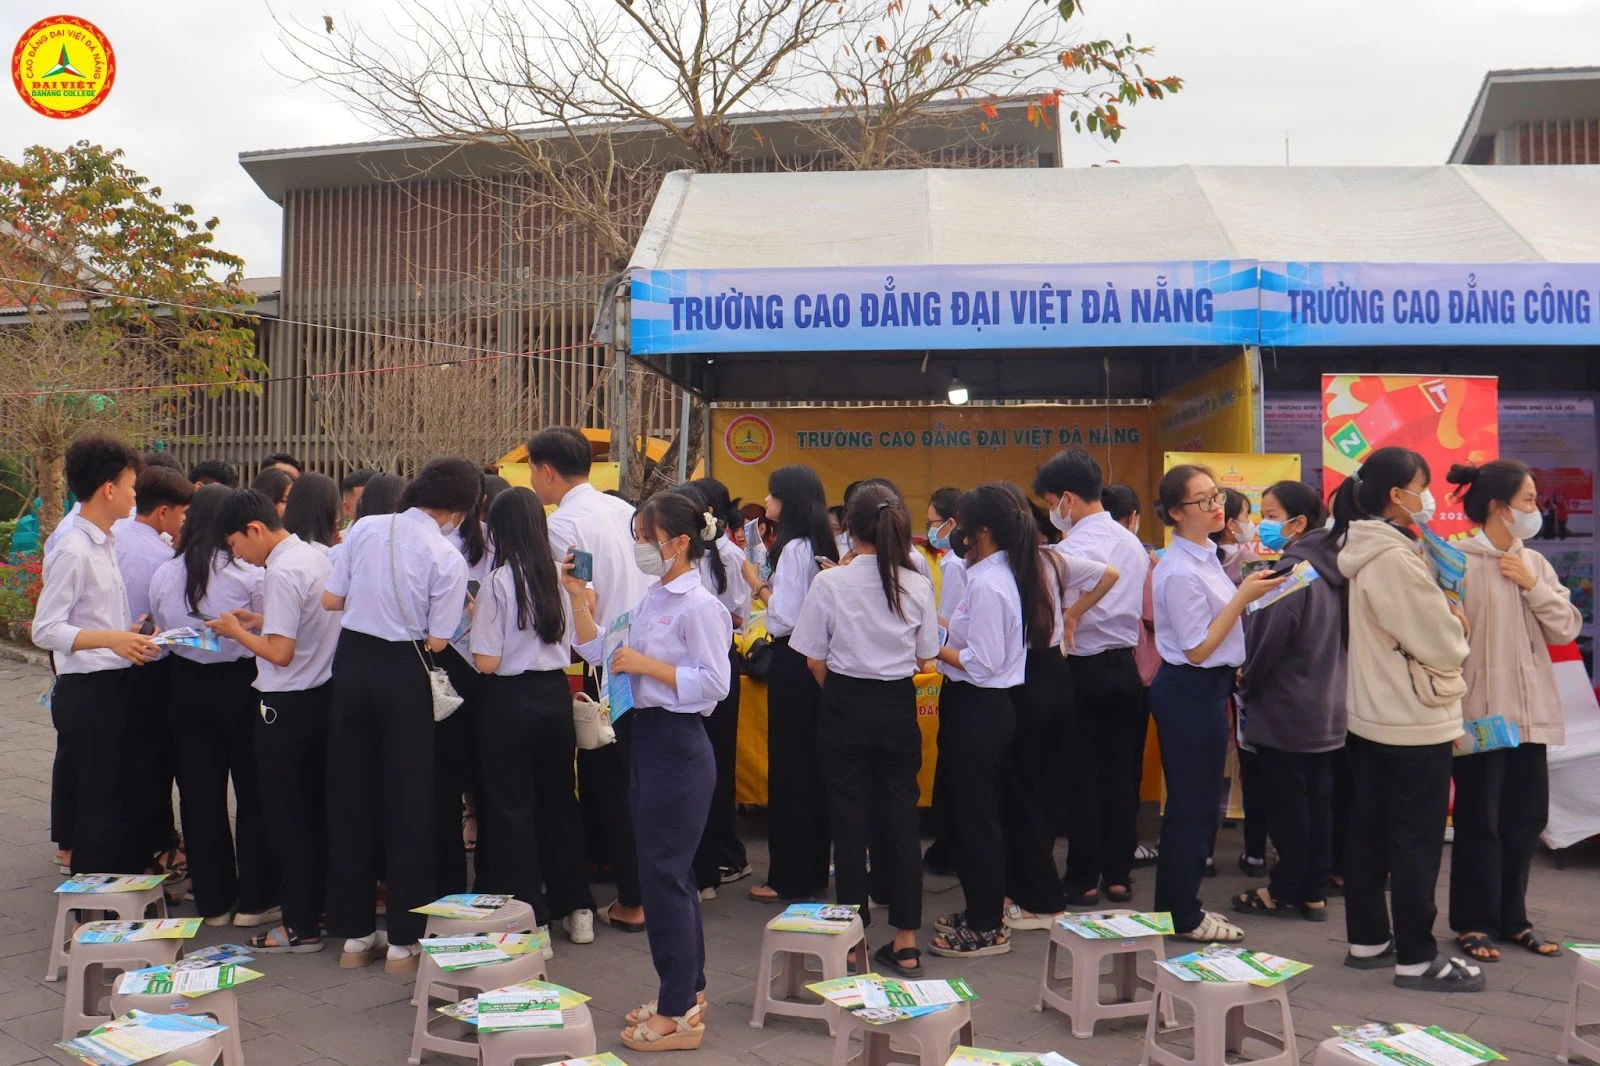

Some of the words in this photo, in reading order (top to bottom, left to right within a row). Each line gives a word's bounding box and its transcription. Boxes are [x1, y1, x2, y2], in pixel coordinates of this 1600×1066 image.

[669, 287, 783, 331] TRƯỜNG
[794, 293, 851, 329] CAO
[860, 276, 941, 328] ĐẲNG
[951, 290, 1000, 332] ĐẠI
[1010, 282, 1072, 331] VIỆT
[1081, 282, 1122, 324] ĐÀ
[1131, 275, 1214, 324] NẴNG
[1288, 281, 1384, 324] TRƯỜNG
[1393, 289, 1440, 324] CAO
[1448, 272, 1515, 324] ĐẲNG
[1524, 283, 1591, 324] CÔNG
[796, 427, 874, 448] TRƯỜNG
[879, 431, 916, 447] CAO
[921, 420, 971, 447] ĐẲNG
[976, 429, 1007, 451] ĐẠI
[1013, 424, 1053, 451] VIỆT
[1058, 424, 1083, 446] ĐÀ
[1088, 419, 1140, 445] NẴNG
